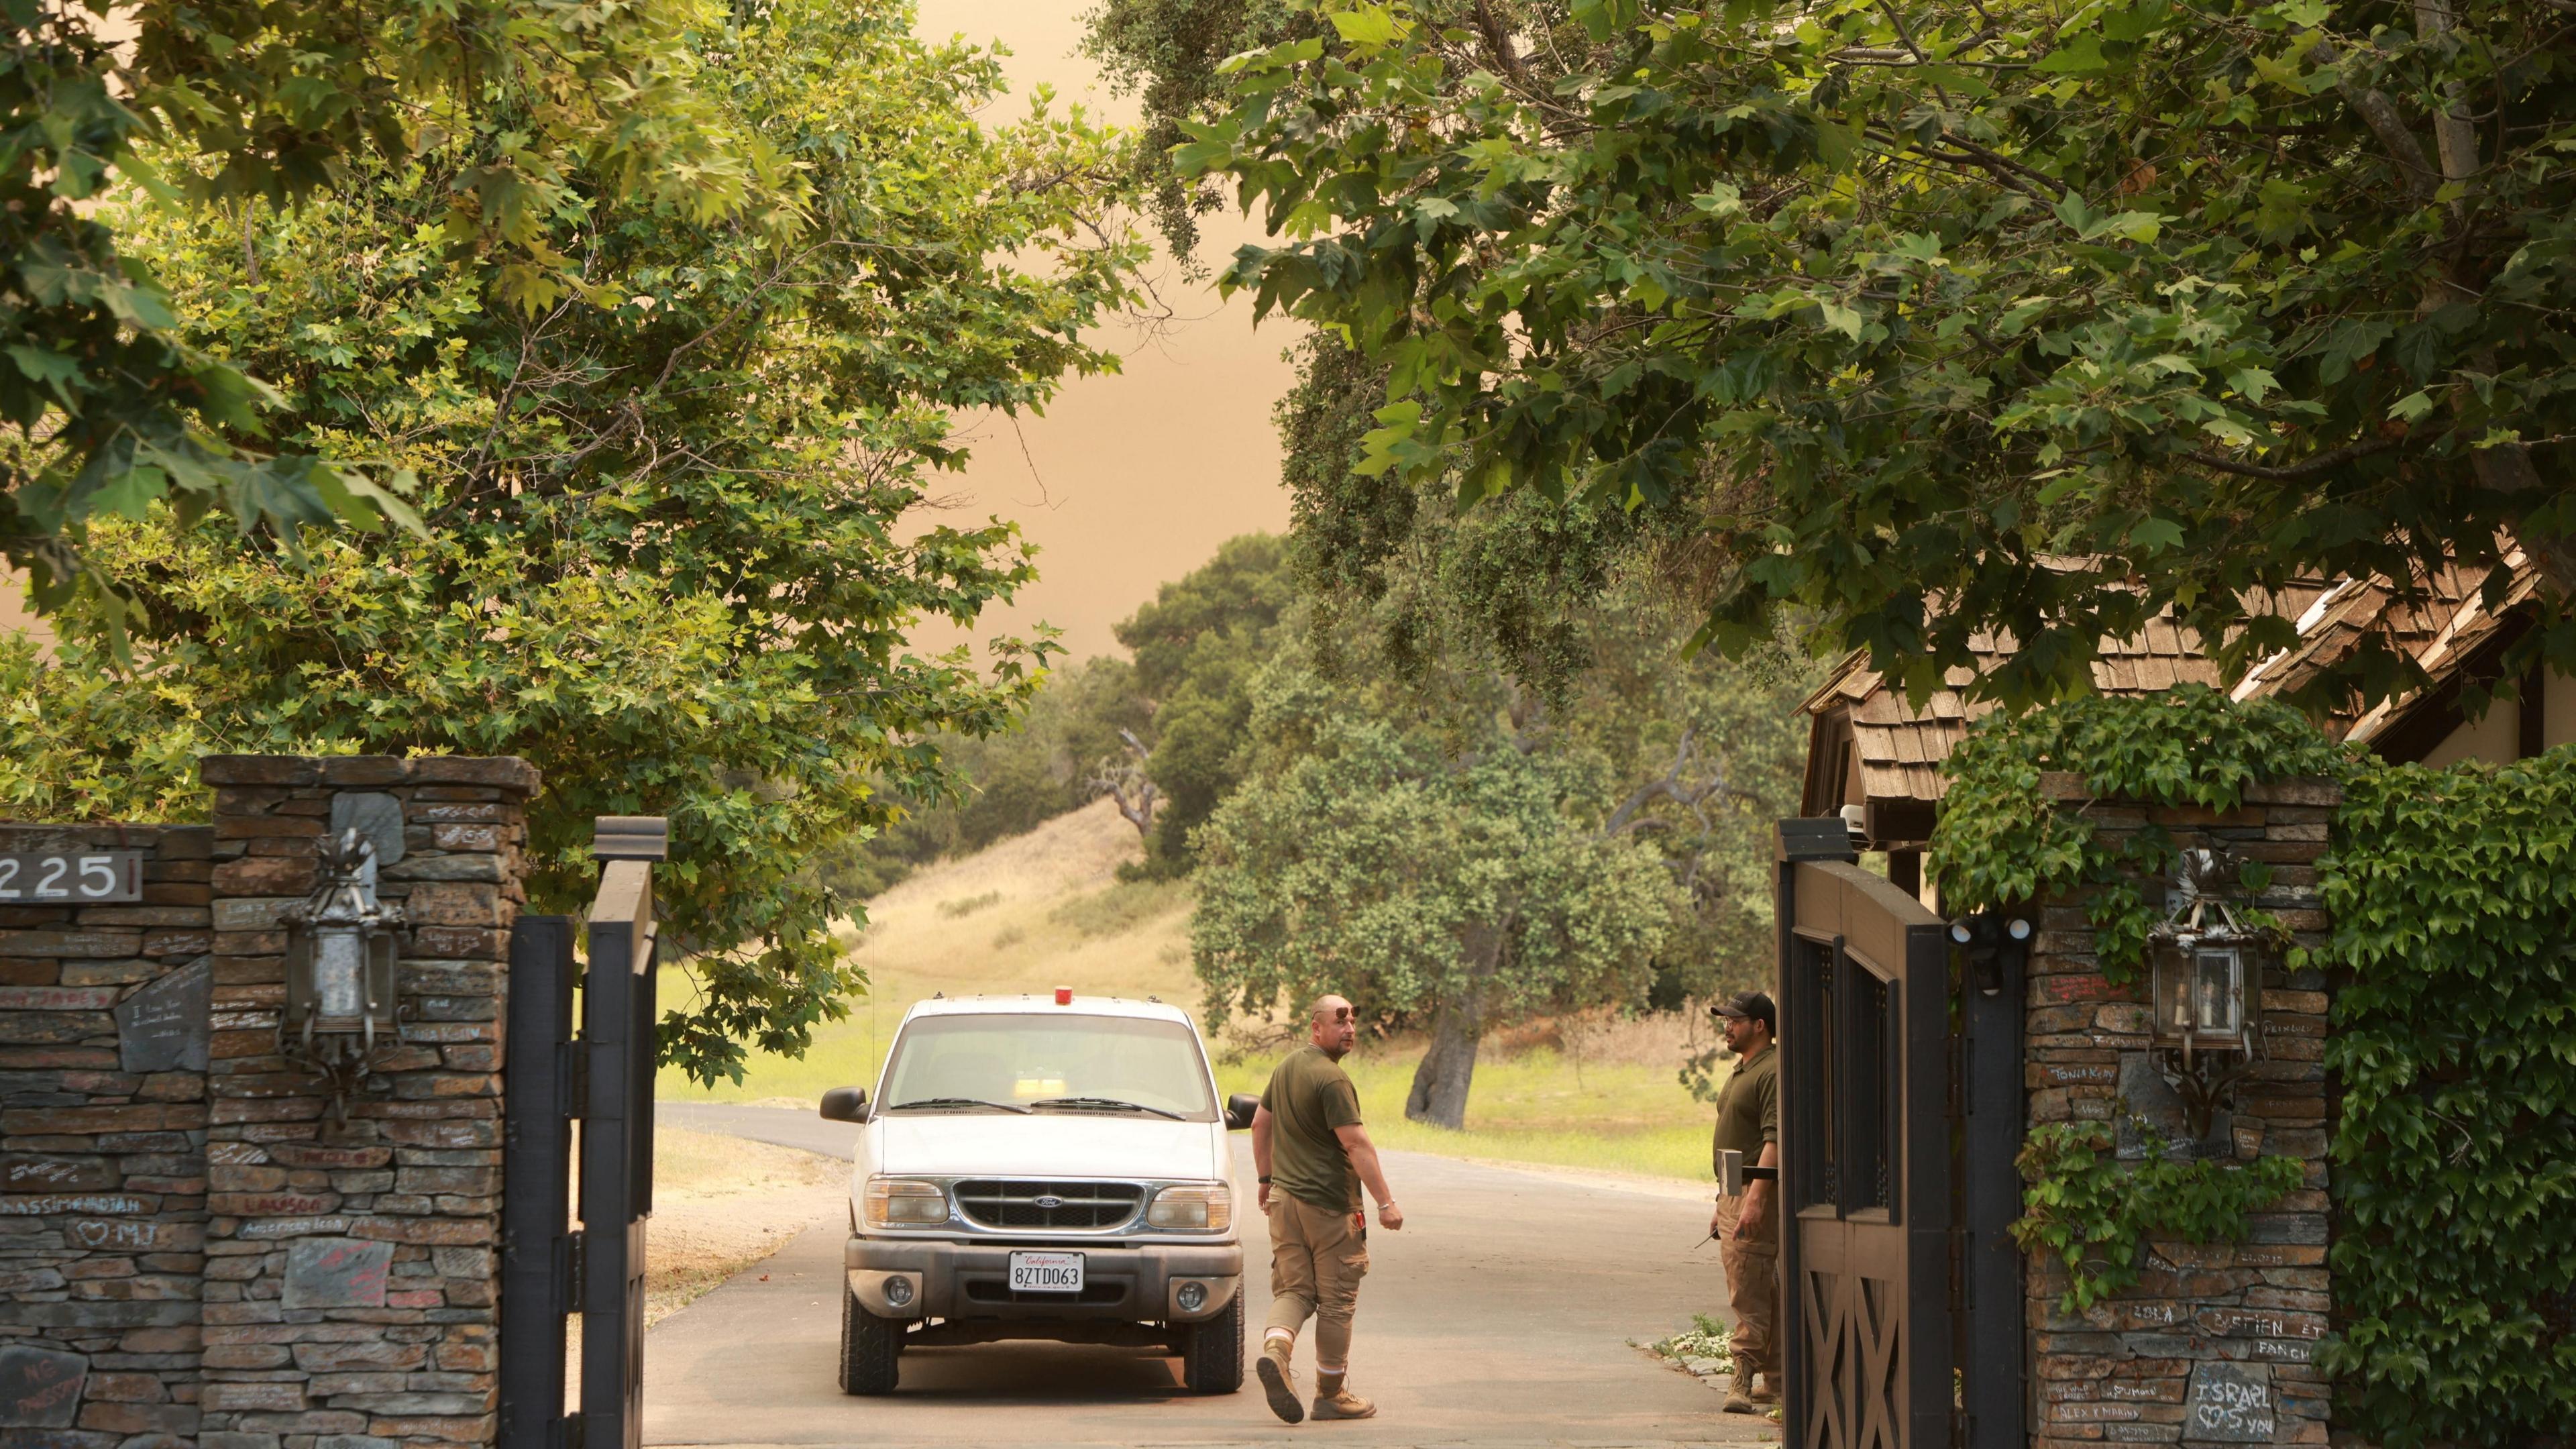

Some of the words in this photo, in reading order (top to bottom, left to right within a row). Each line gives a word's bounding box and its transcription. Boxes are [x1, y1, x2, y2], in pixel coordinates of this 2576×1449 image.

[0, 856, 117, 898] 225
[116, 1223, 158, 1246] MJ
[1025, 1256, 1070, 1267] California
[1015, 1267, 1078, 1285] 8ZTD063
[2059, 1407, 2088, 1419] ALEX
